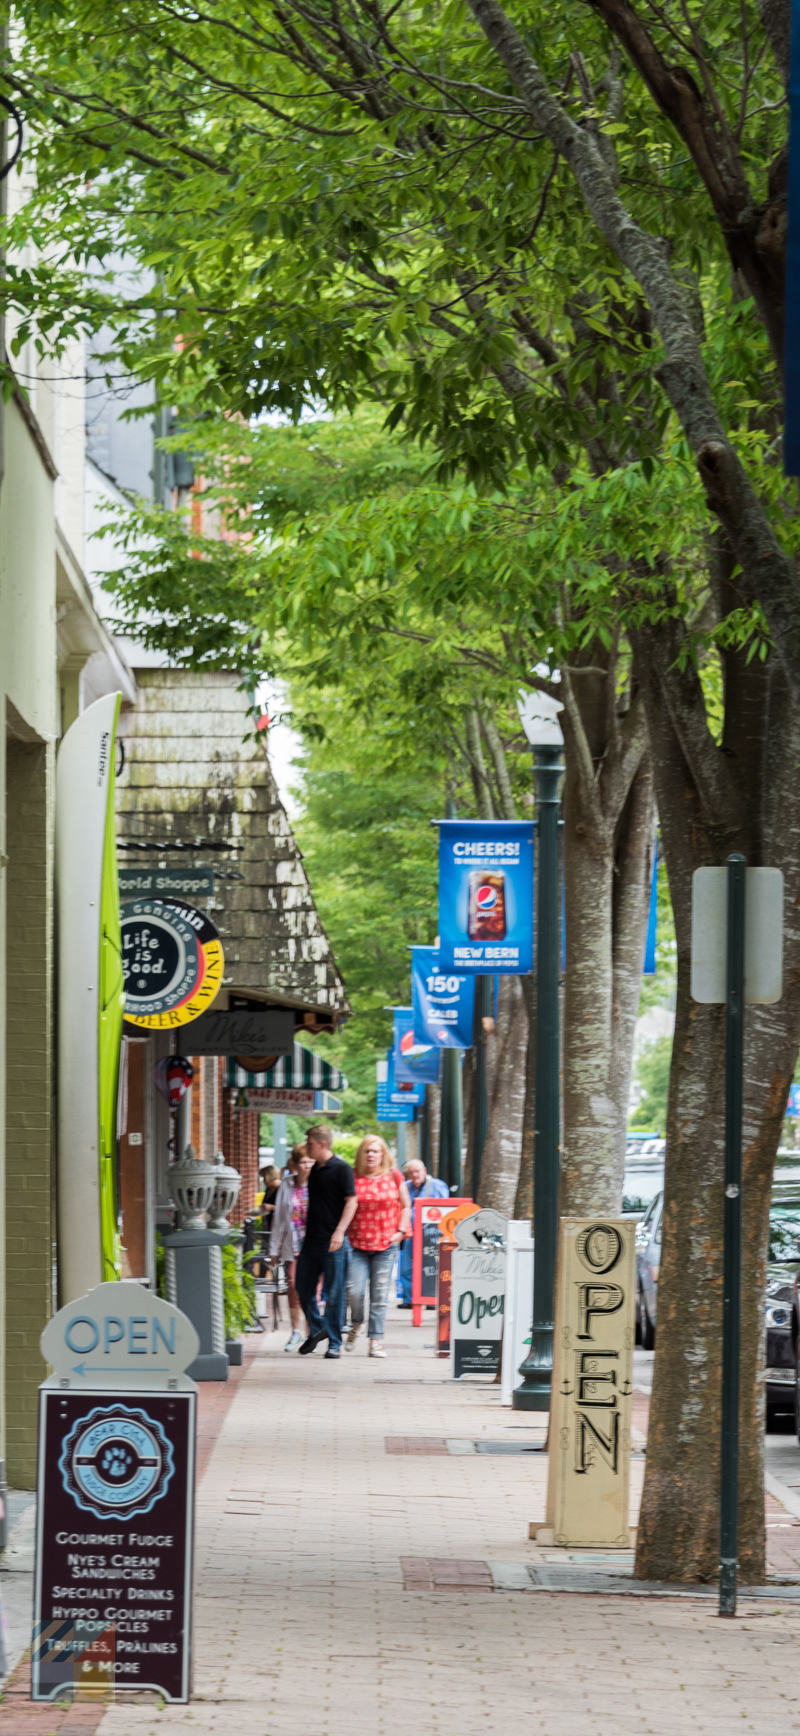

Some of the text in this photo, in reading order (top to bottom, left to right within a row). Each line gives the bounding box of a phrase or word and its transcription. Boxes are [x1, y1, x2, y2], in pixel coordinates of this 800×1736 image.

[98, 732, 109, 776] Santee
[452, 842, 521, 856] CHEERS!
[118, 876, 211, 893] orld Shoppe
[123, 929, 160, 950] Life
[134, 948, 152, 962] is
[453, 947, 484, 959] NEW
[484, 947, 520, 959] BERN
[134, 946, 220, 1027] BEER & WINE
[164, 968, 196, 1006] Shoppe
[205, 1013, 269, 1045] Mike's
[64, 1315, 176, 1354] OPEN
[573, 1223, 627, 1475] OPEN
[89, 1424, 147, 1448] BEAR CITY
[83, 1474, 149, 1500] FUDGE COMPANY
[55, 1531, 174, 1547] GOURMET FUDGE
[67, 1553, 160, 1567] NYE'S CREAM
[71, 1566, 156, 1580] SANDWICHES
[52, 1585, 174, 1601] SPECIALTY DRINKS
[52, 1606, 173, 1621] HYPPO GOURMET
[75, 1619, 149, 1633] POPSICLES
[46, 1638, 112, 1653] TRUFFLES,
[81, 1660, 141, 1673] & MORE
